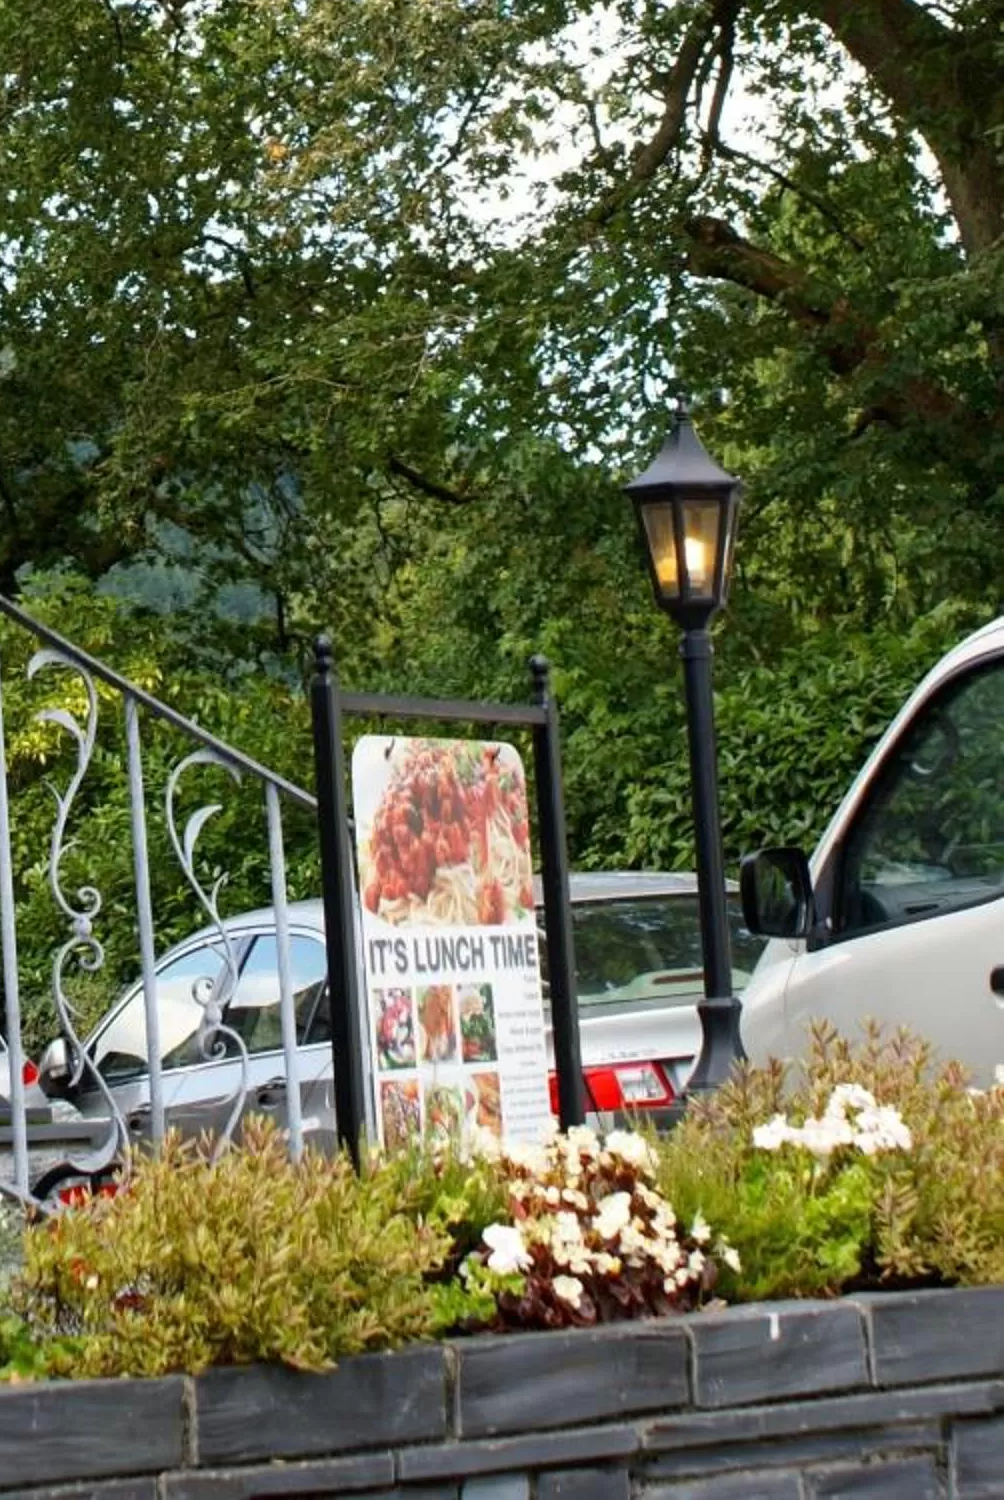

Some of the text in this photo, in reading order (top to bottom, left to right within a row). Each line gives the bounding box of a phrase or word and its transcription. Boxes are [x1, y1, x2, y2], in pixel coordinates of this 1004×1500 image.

[369, 934, 536, 975] IT'S LUNCH TIME
